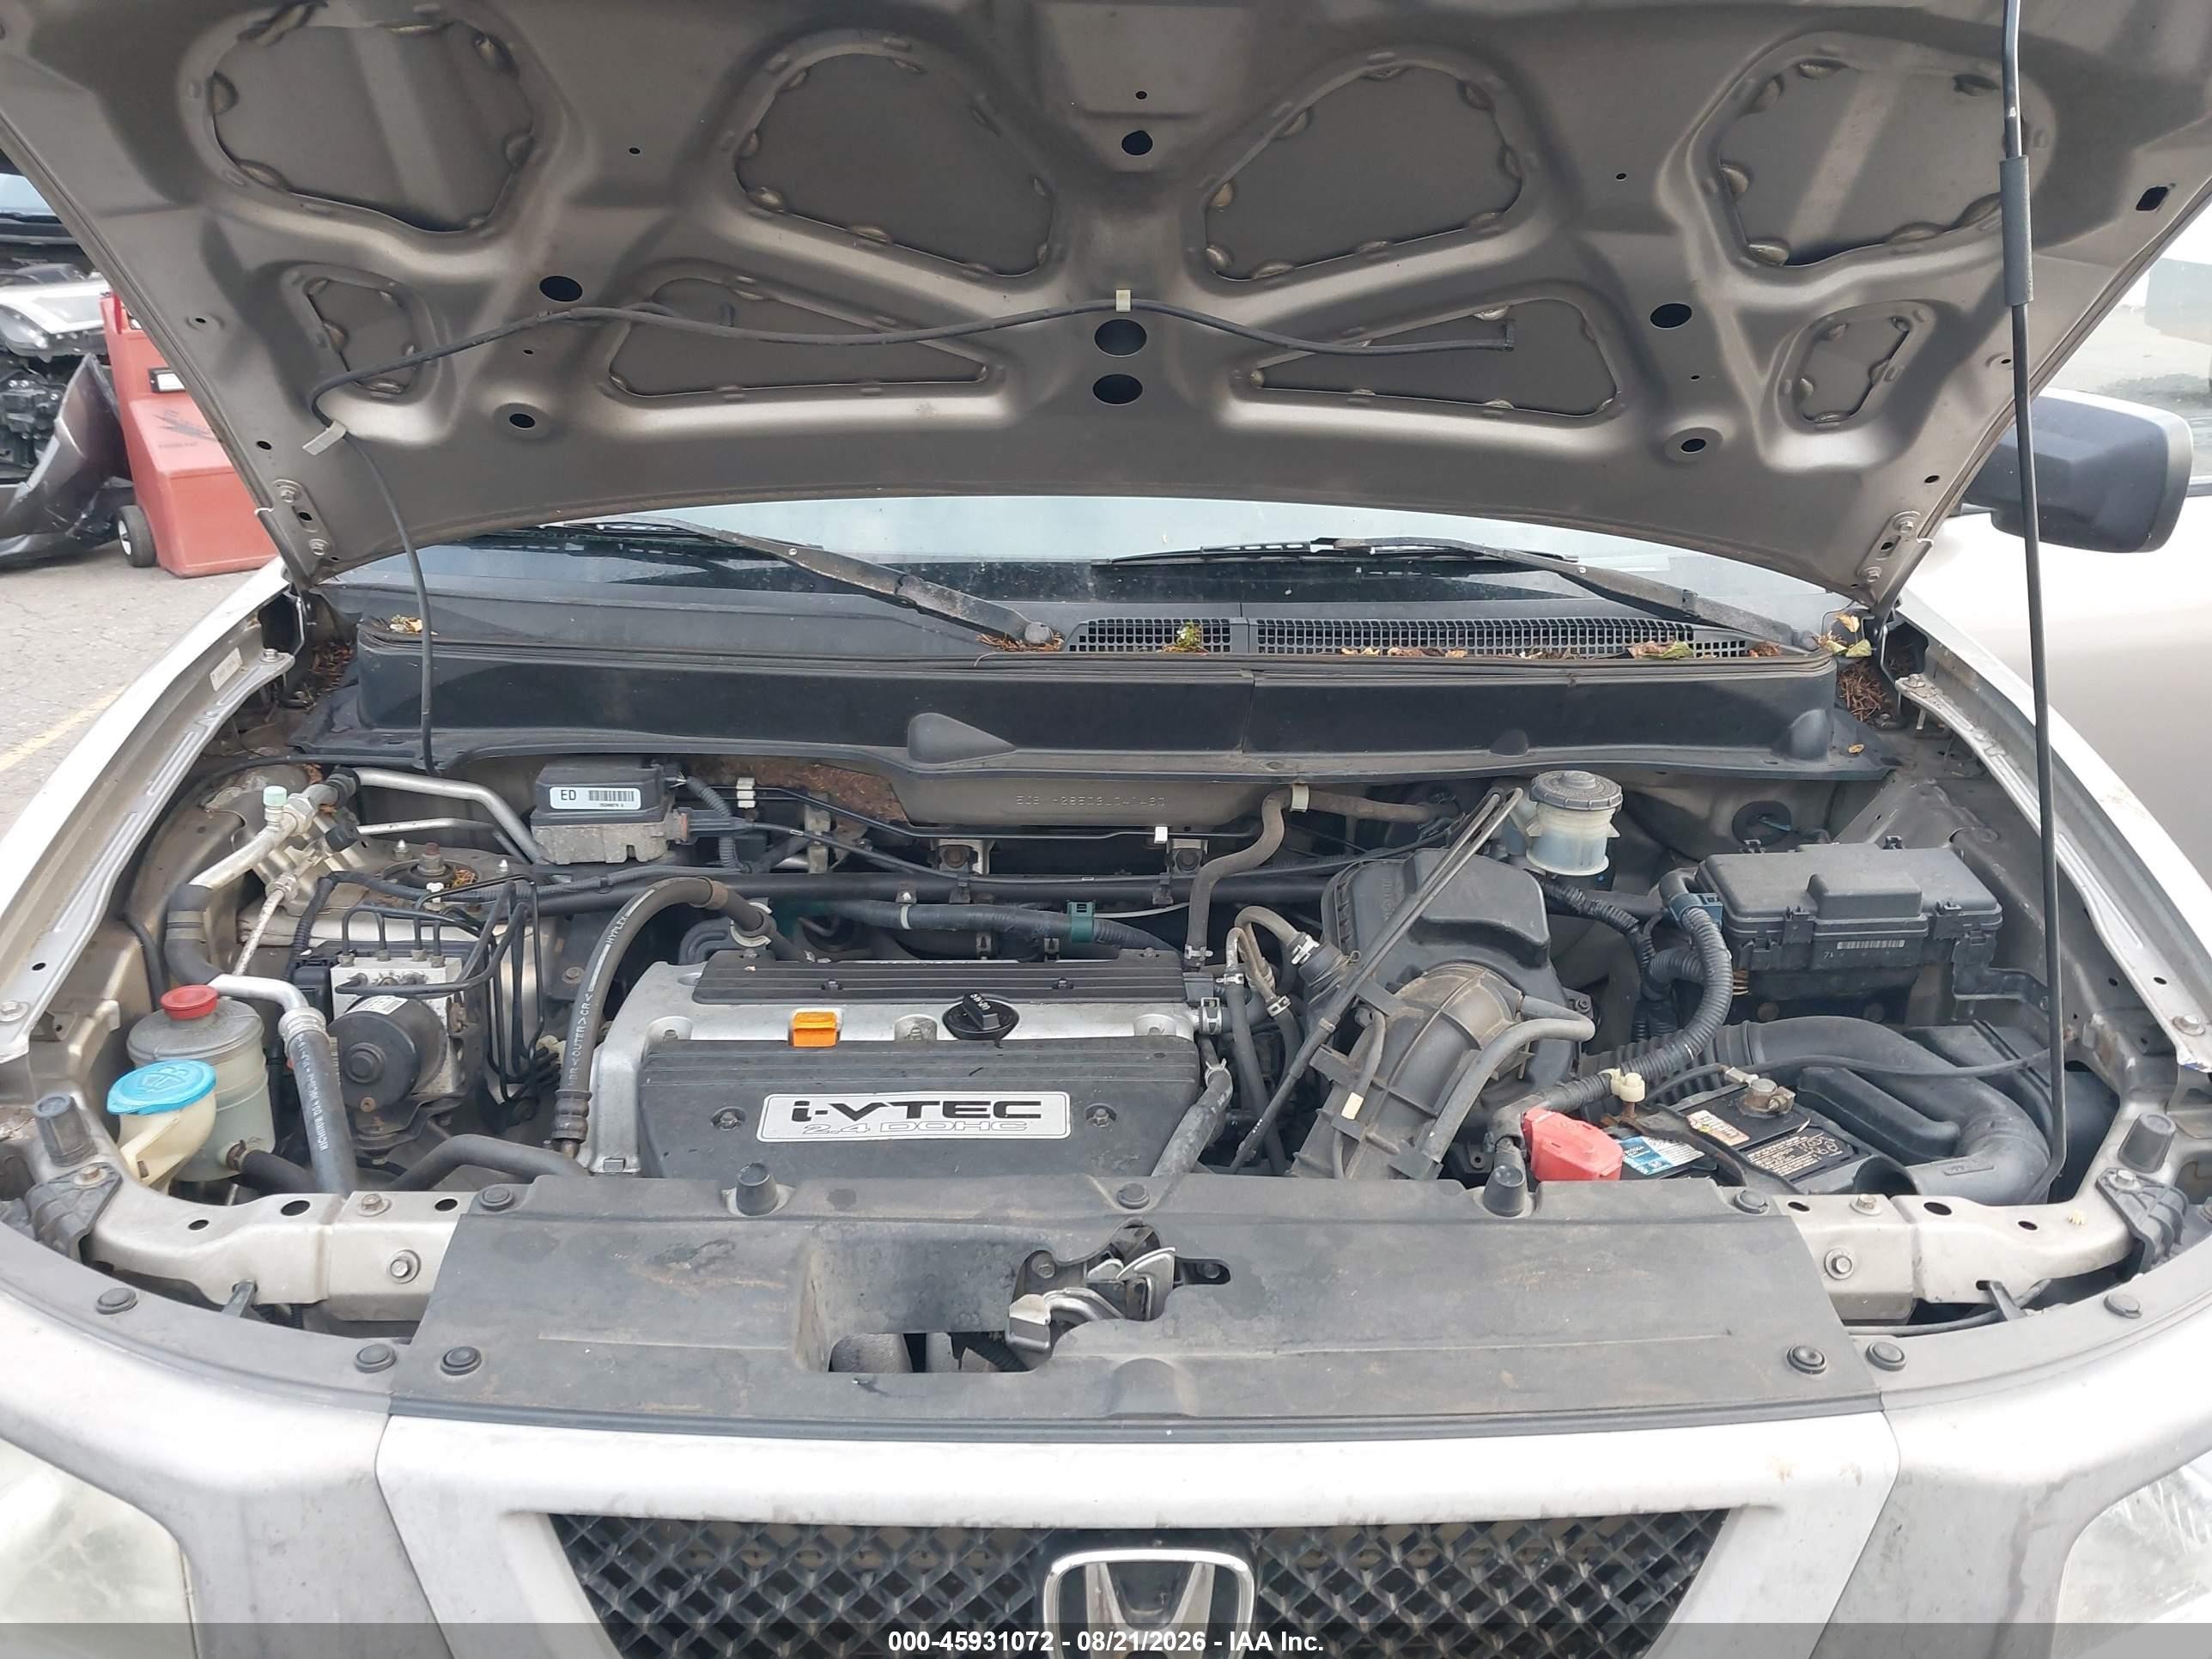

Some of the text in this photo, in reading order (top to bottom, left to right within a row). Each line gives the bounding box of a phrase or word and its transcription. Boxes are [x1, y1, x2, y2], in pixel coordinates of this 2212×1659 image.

[561, 789, 576, 801] ED
[791, 1100, 1042, 1122] i-VTEC
[803, 1120, 1030, 1134] 2.4 DOHC
